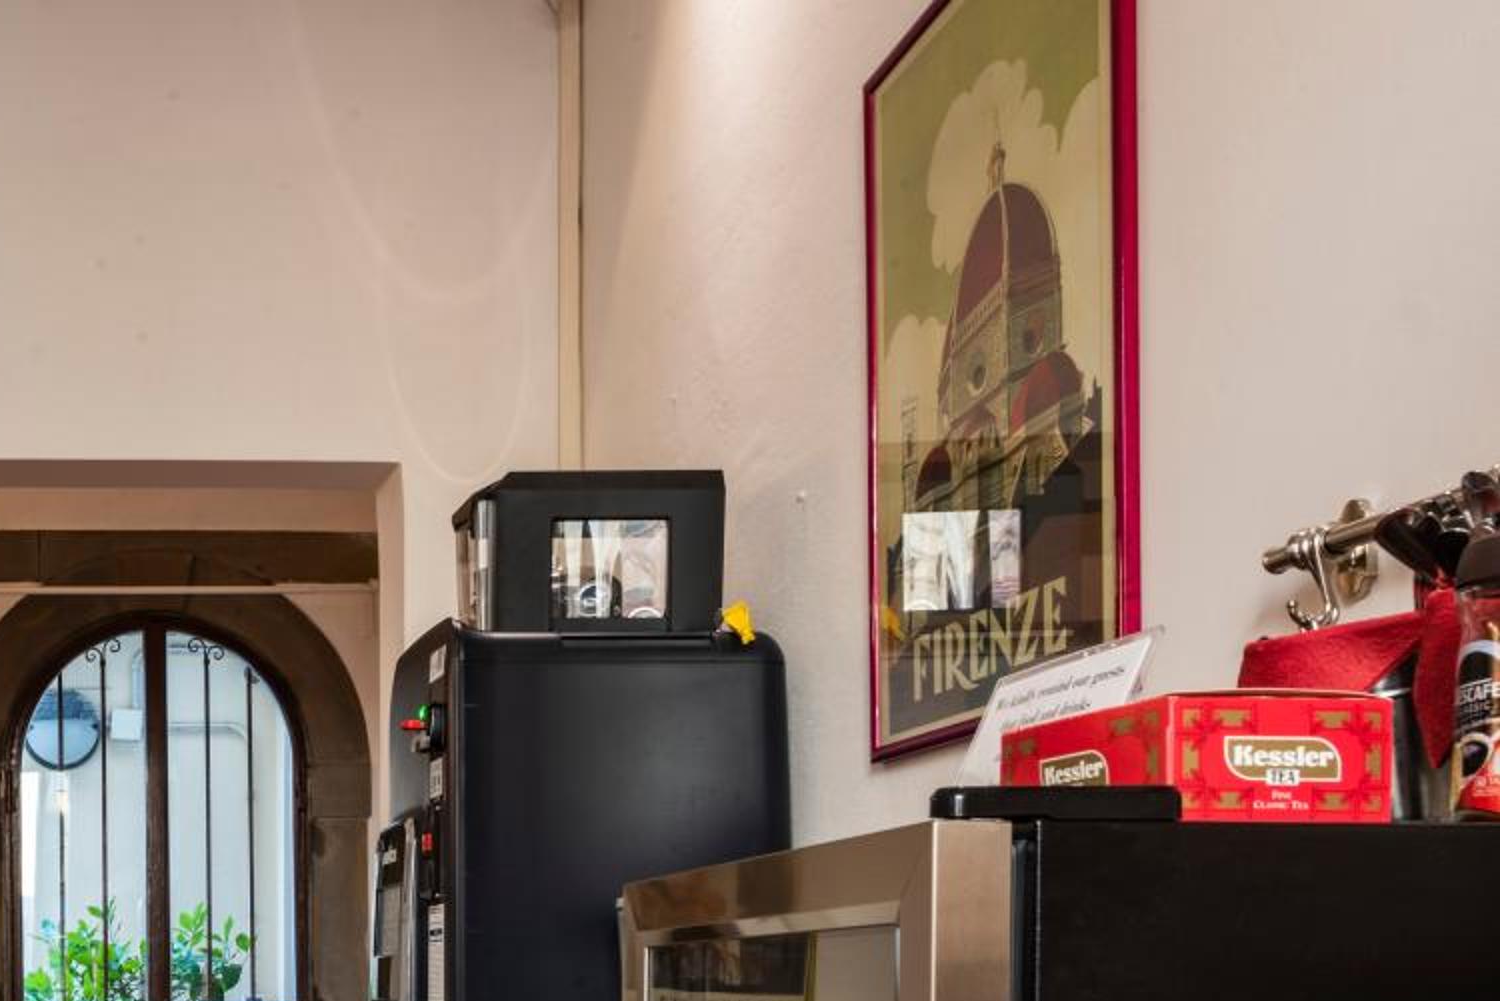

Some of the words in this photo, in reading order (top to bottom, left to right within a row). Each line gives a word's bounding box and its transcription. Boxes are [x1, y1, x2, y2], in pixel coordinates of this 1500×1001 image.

[913, 576, 1069, 701] FIRENZE
[1233, 744, 1334, 767] Kessler
[1045, 760, 1103, 786] Kessler
